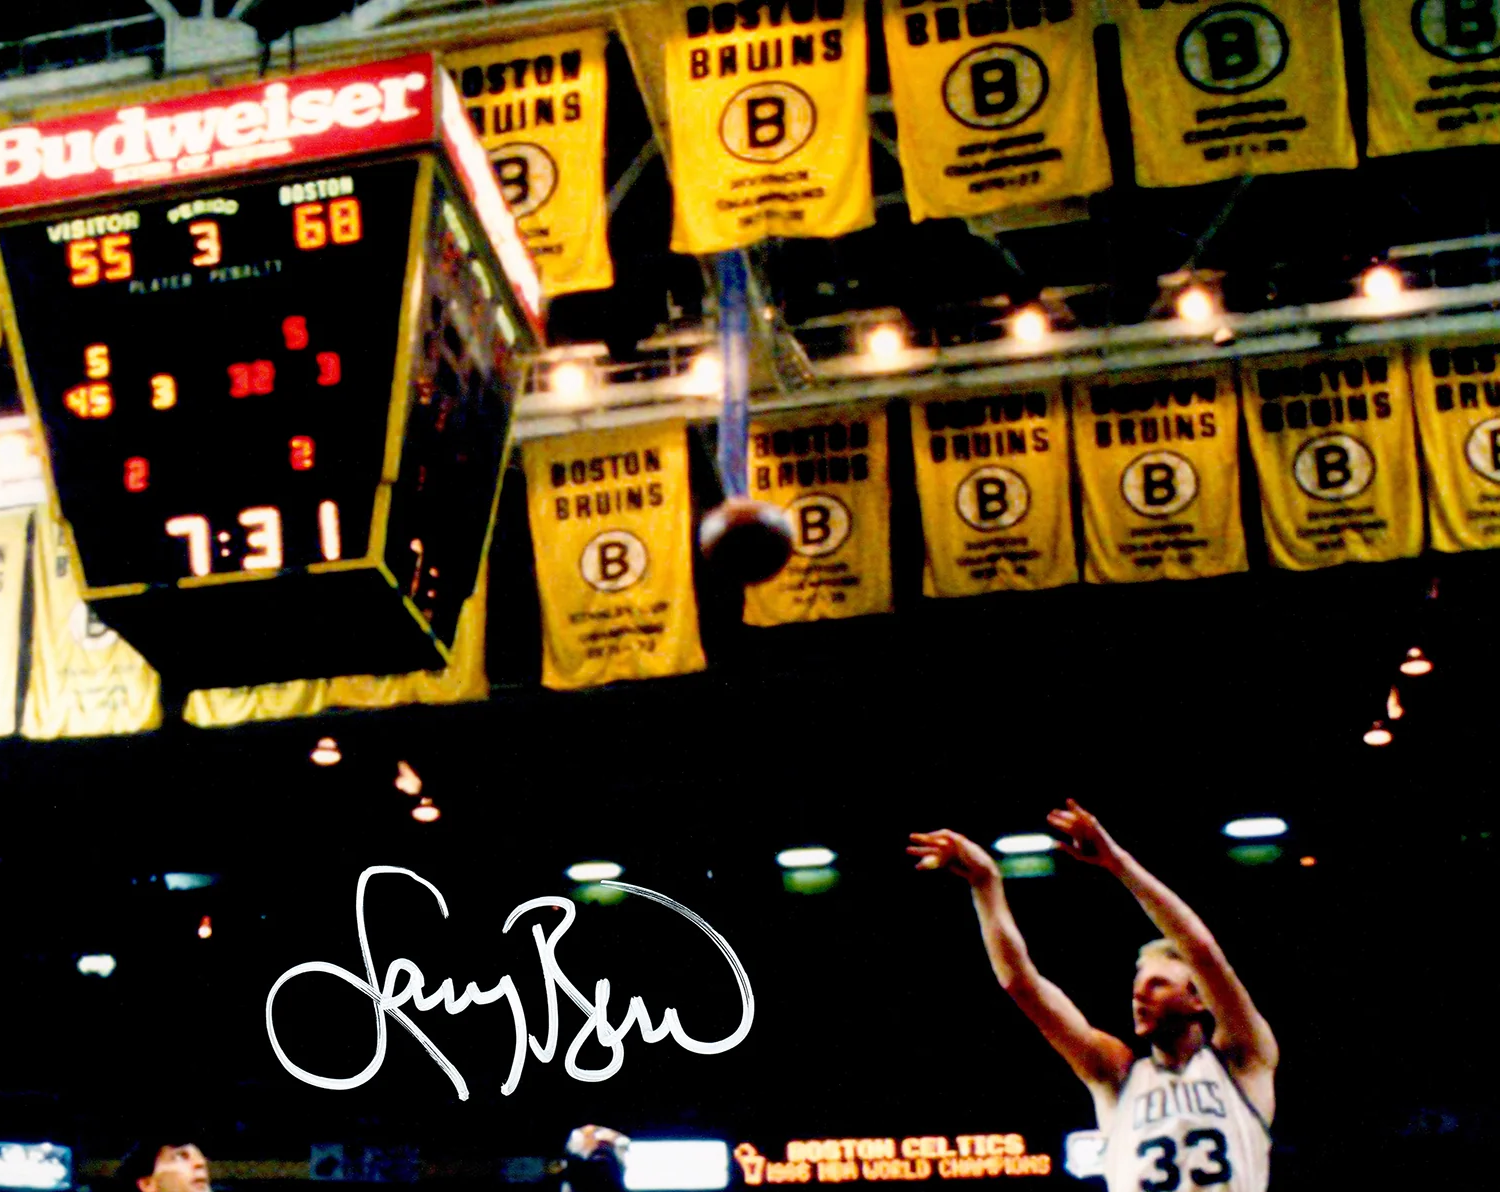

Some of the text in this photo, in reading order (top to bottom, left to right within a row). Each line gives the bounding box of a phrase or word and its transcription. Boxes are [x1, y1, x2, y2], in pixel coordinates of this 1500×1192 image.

[687, 0, 845, 38] BOSTON
[690, 29, 843, 80] BRUINS
[1204, 18, 1260, 80] B
[452, 49, 581, 97] OSTON
[971, 58, 1019, 116] B
[468, 92, 581, 136] RUINS
[747, 97, 785, 148] B
[279, 176, 354, 206] BOSTON
[47, 210, 140, 243] VISITOR
[189, 220, 222, 267] 3
[293, 197, 362, 250] 68
[66, 233, 133, 287] 55
[84, 342, 111, 380] 5
[150, 372, 178, 410] 3
[930, 427, 1049, 463] BRUINS
[1095, 412, 1216, 448] BRUINS
[551, 448, 661, 488] BOSTON
[1144, 463, 1177, 506] B
[1315, 445, 1352, 490] B
[555, 482, 664, 520] BRUINS
[977, 477, 1008, 521] B
[165, 500, 341, 577] 7:31
[800, 505, 831, 546] B
[599, 541, 629, 581] B
[787, 1133, 1026, 1163] BOSTON CELTICS
